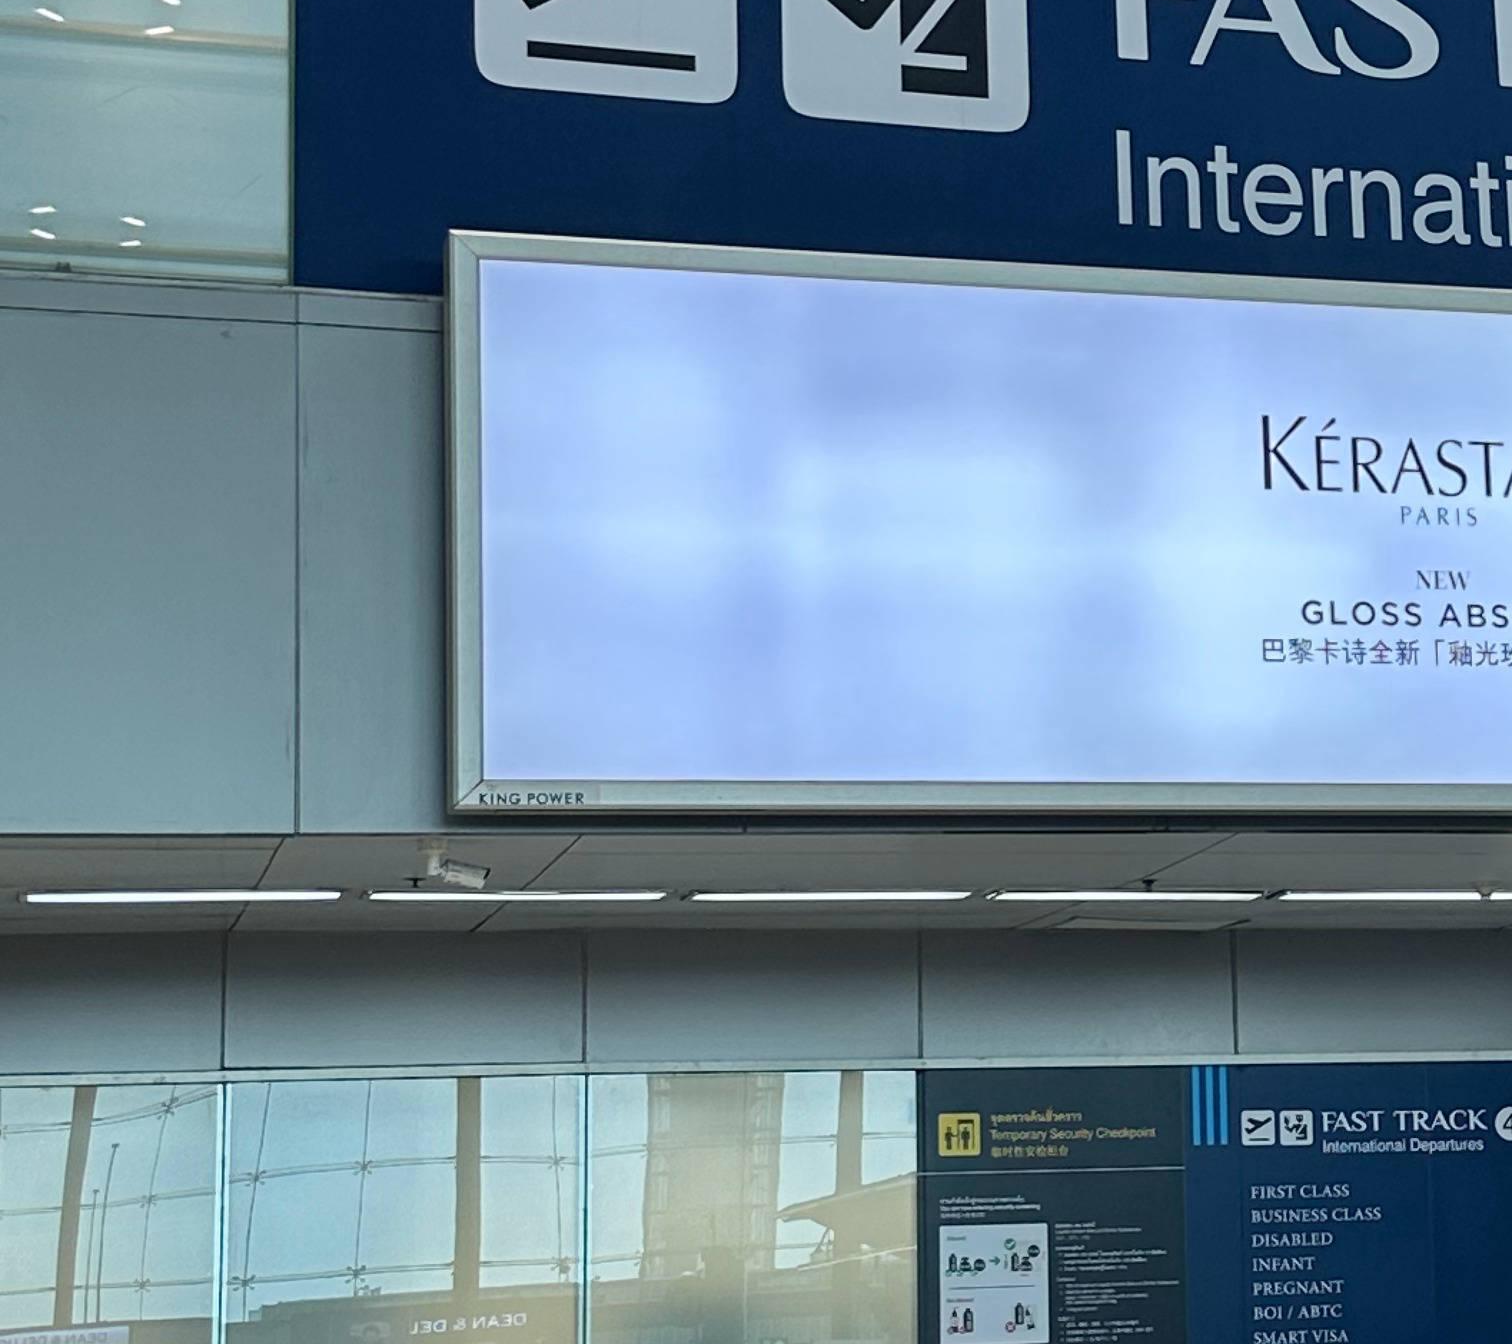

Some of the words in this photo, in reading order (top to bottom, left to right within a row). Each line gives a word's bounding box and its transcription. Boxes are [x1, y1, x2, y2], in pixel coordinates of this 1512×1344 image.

[1400, 505, 1478, 526] PARIS
[1415, 570, 1470, 590] NEW
[1302, 600, 1422, 626] GLOSS
[478, 792, 521, 805] KING
[527, 792, 584, 805] POWER
[1322, 1110, 1384, 1133] FAST
[1392, 1109, 1488, 1132] TRACK
[990, 1129, 1047, 1142] Temporary
[1050, 1128, 1093, 1141] Security
[1322, 1139, 1406, 1154] International
[1410, 1138, 1484, 1154] Departures
[1251, 1185, 1296, 1199] FIRST
[1300, 1184, 1350, 1198] CLASS
[1251, 1209, 1328, 1223] BUSINESS
[1332, 1207, 1382, 1221] CLASS
[1252, 1232, 1333, 1247] DISABLED
[1252, 1256, 1316, 1271] INFANT
[1252, 1280, 1344, 1296] PREGNANT
[1254, 1306, 1282, 1320] BOI
[1298, 1304, 1342, 1319] ABTC
[1253, 1330, 1308, 1344] SMART
[1312, 1329, 1348, 1343] VISA
